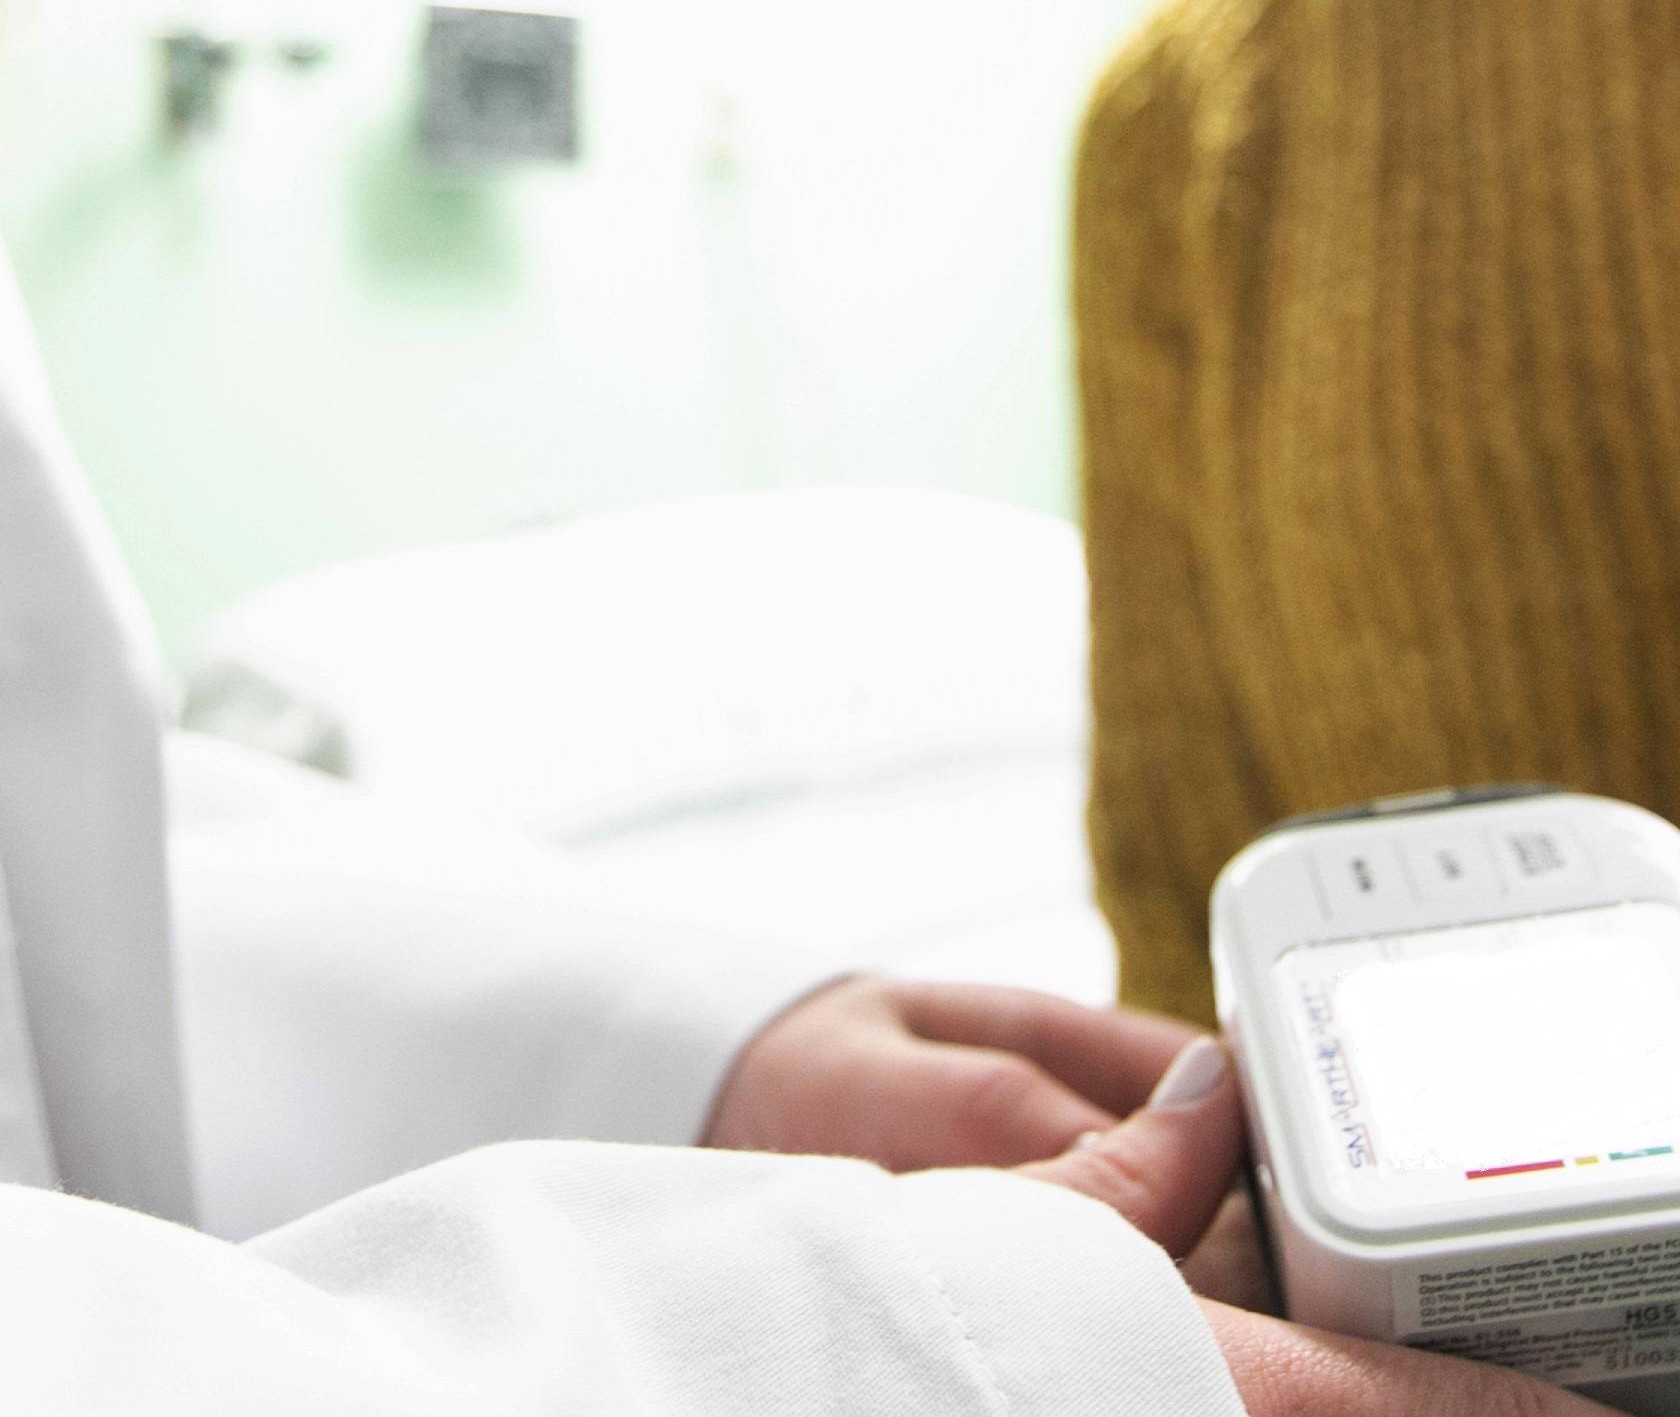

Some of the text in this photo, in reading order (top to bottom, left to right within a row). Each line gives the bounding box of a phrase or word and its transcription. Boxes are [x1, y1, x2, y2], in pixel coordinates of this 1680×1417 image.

[1445, 1267, 1491, 1279] product
[1495, 1258, 1547, 1272] complies
[1552, 1254, 1577, 1263] with
[1580, 1249, 1604, 1260] Part
[1625, 1244, 1638, 1253] of
[1641, 1241, 1660, 1251] the
[1539, 1269, 1552, 1277] to
[1555, 1265, 1574, 1274] the
[1465, 1285, 1510, 1299] product
[1464, 1297, 1508, 1310] product
